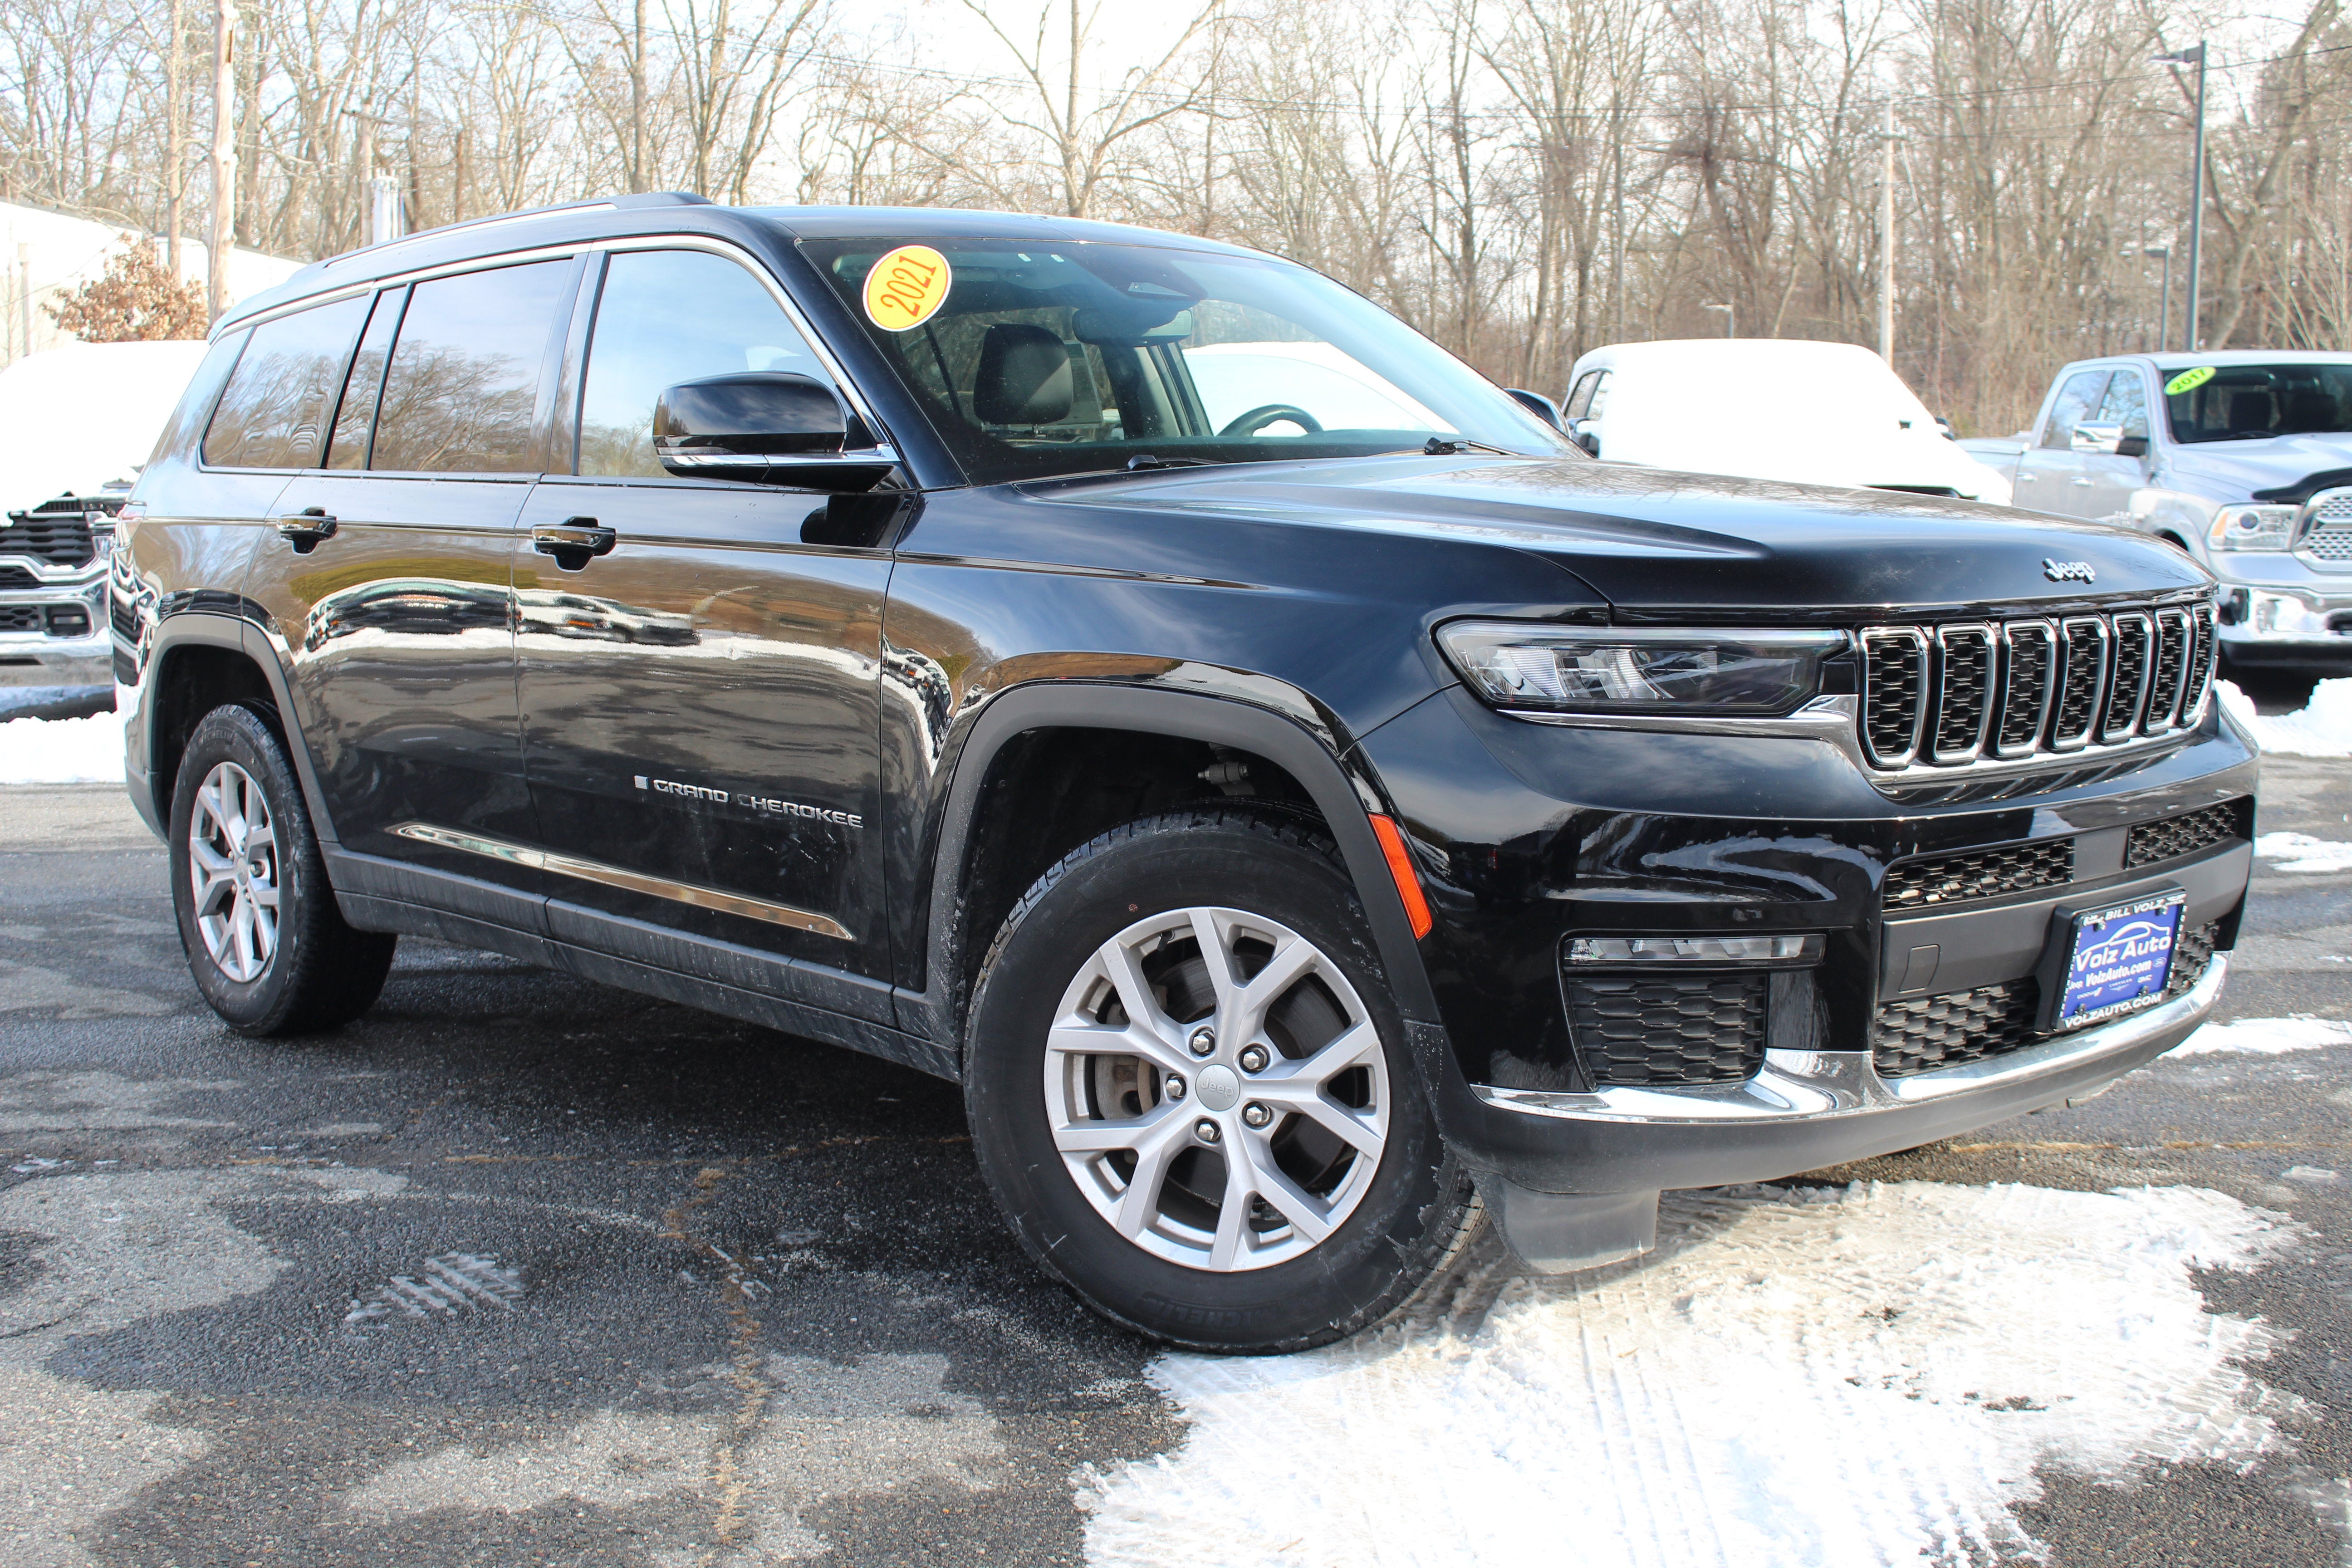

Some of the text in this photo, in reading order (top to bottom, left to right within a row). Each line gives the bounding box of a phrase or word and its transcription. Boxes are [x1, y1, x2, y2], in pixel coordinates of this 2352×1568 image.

[880, 255, 937, 317] 2021
[2171, 368, 2206, 391] 2017
[2043, 558, 2096, 583] Jeep
[653, 779, 863, 829] GRAND CHEROKEE
[2104, 907, 2131, 921] BILL
[2133, 898, 2165, 914] VOLZ
[2075, 936, 2172, 972] Volz Auto
[2085, 960, 2152, 987] VolzAuto.com
[2065, 993, 2163, 1029] VOLZAUTO.COM
[1200, 1078, 1234, 1098] Jeep
